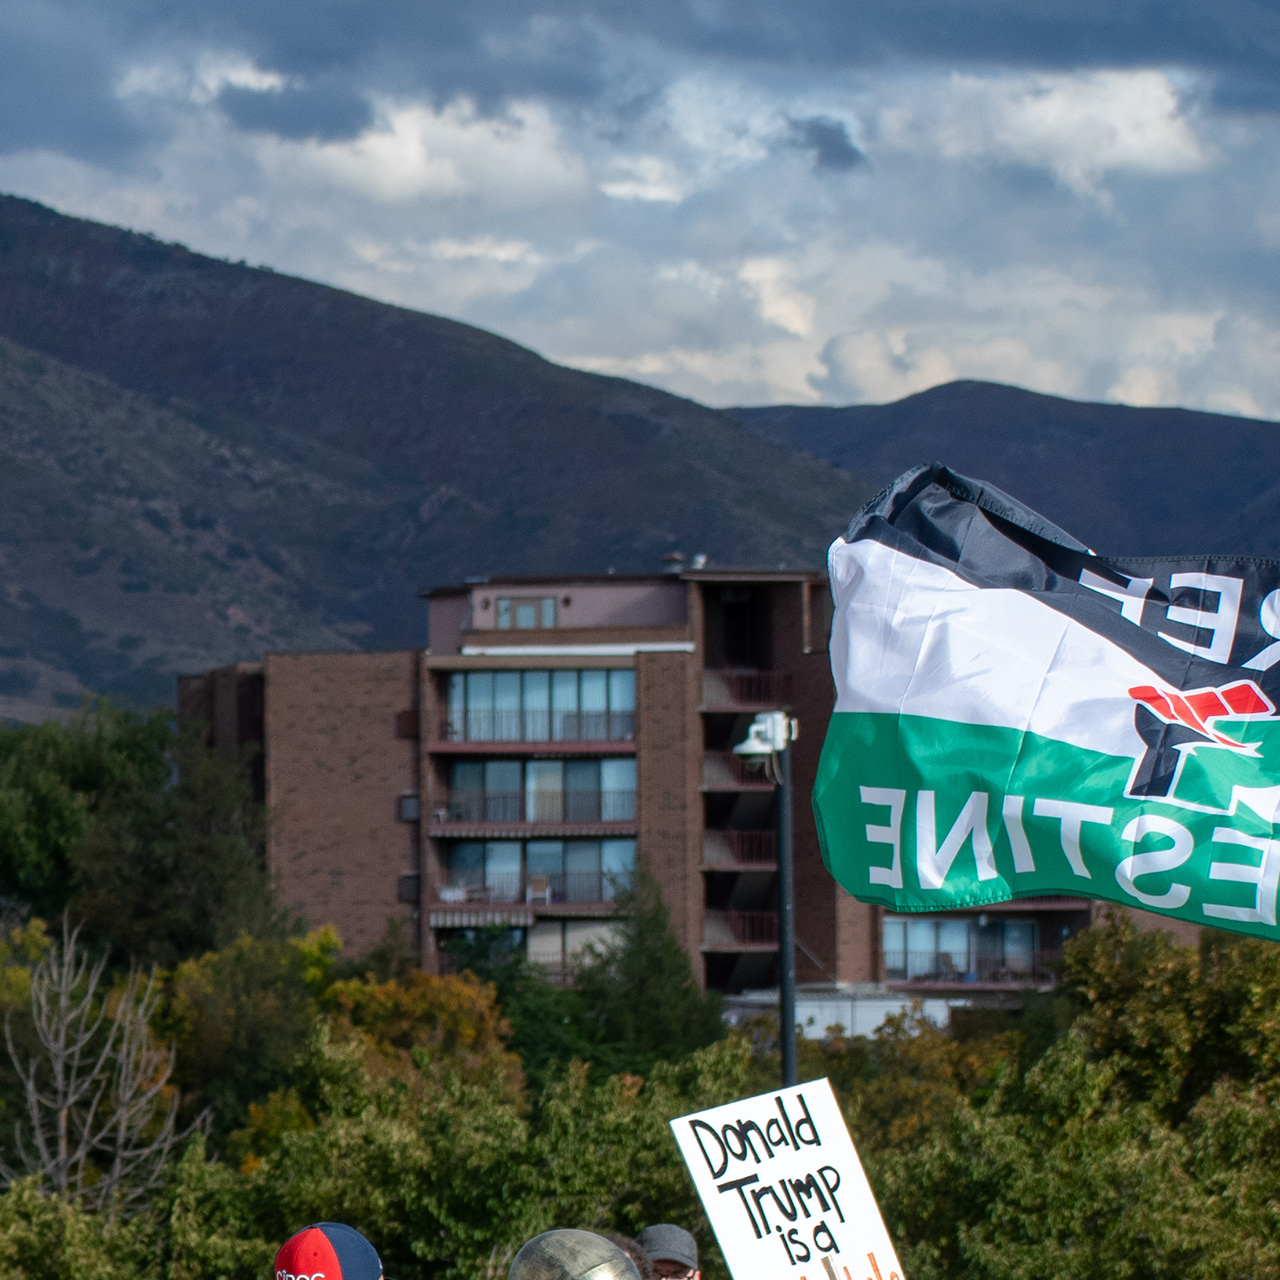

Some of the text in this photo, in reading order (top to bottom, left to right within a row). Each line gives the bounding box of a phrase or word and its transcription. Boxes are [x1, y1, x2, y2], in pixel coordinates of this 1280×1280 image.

[688, 1093, 822, 1180] Donald
[716, 1165, 846, 1240] Trump
[775, 1220, 840, 1266] is a
